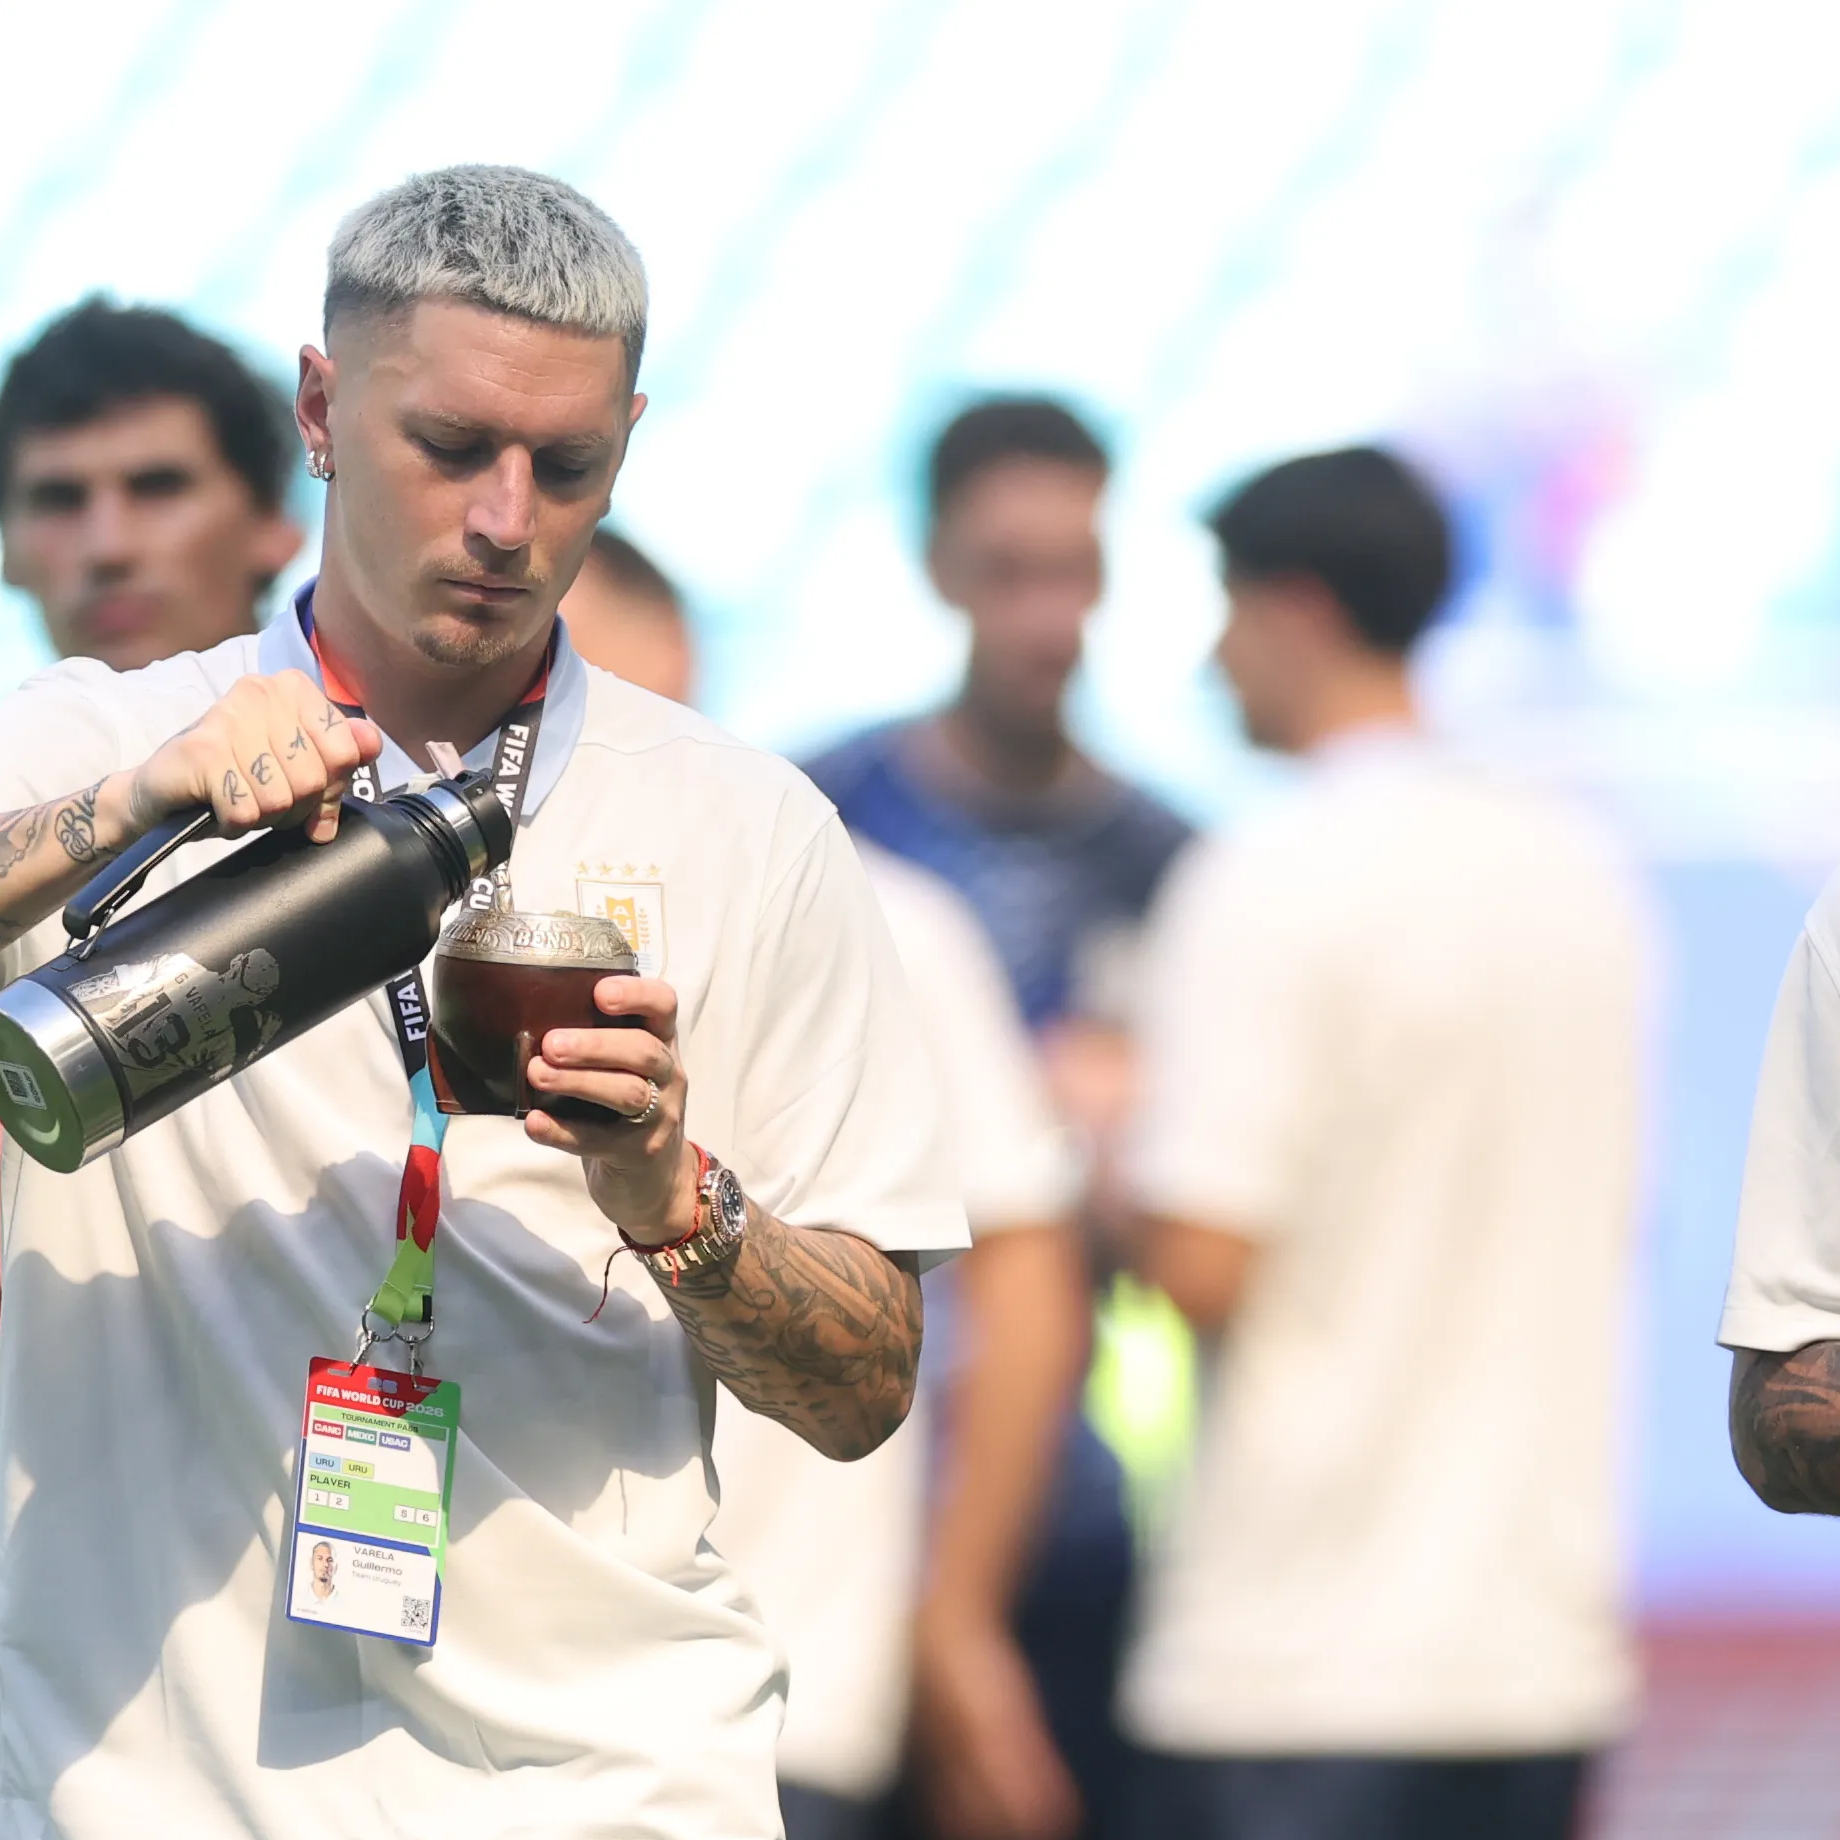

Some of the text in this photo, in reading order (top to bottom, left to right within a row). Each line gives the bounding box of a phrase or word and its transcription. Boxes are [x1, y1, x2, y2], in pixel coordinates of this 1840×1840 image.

[498, 724, 530, 777] FIFA
[469, 877, 494, 910] CU
[397, 981, 427, 1042] FIFA
[316, 1384, 444, 1417] FIFA WORLD CUP 2026
[341, 1412, 419, 1434] TOURNAMENT PASS
[315, 1457, 368, 1474] URU URU
[310, 1474, 351, 1490] PLAYER
[335, 1497, 343, 1506] 2
[422, 1512, 430, 1522] 6
[354, 1546, 395, 1561] VARELA
[352, 1559, 403, 1576] Guillermo
